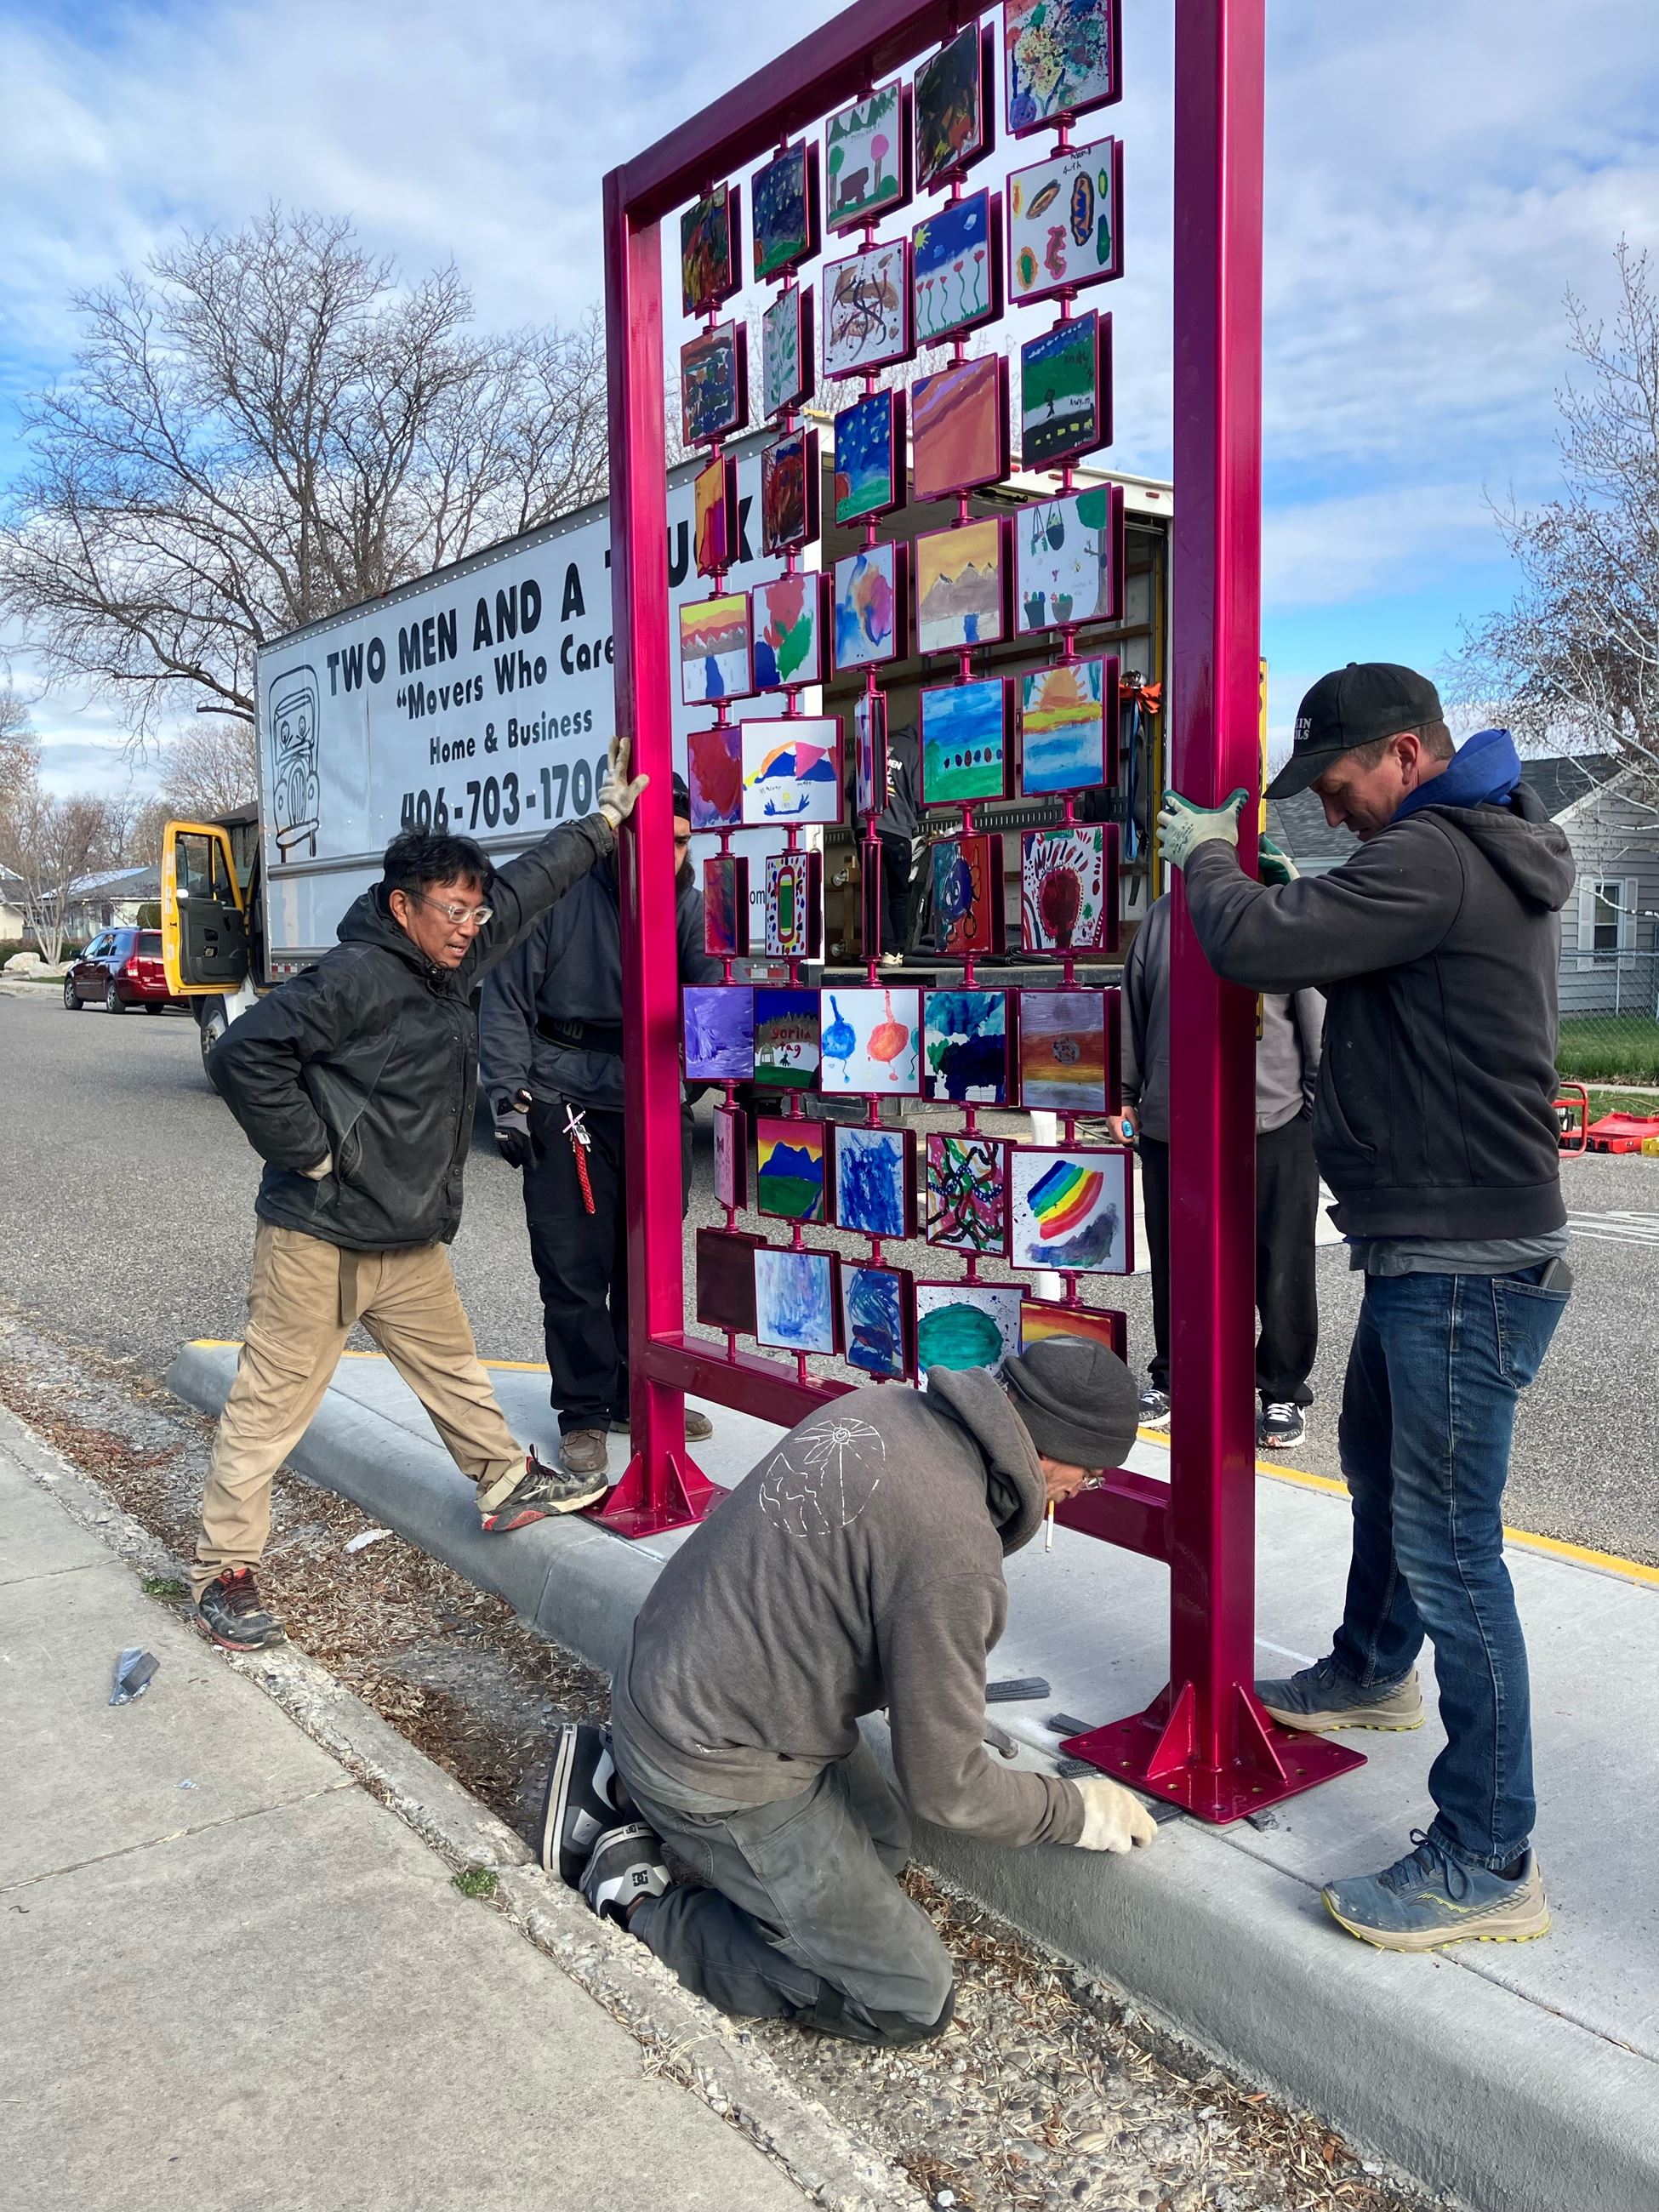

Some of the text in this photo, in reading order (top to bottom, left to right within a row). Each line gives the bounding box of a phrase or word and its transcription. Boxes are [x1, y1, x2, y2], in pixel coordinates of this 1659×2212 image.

[327, 562, 586, 697] TWO MEN AND A
[493, 649, 547, 695] Who
[430, 709, 593, 765] Home & Business
[779, 1041, 801, 1058] tag
